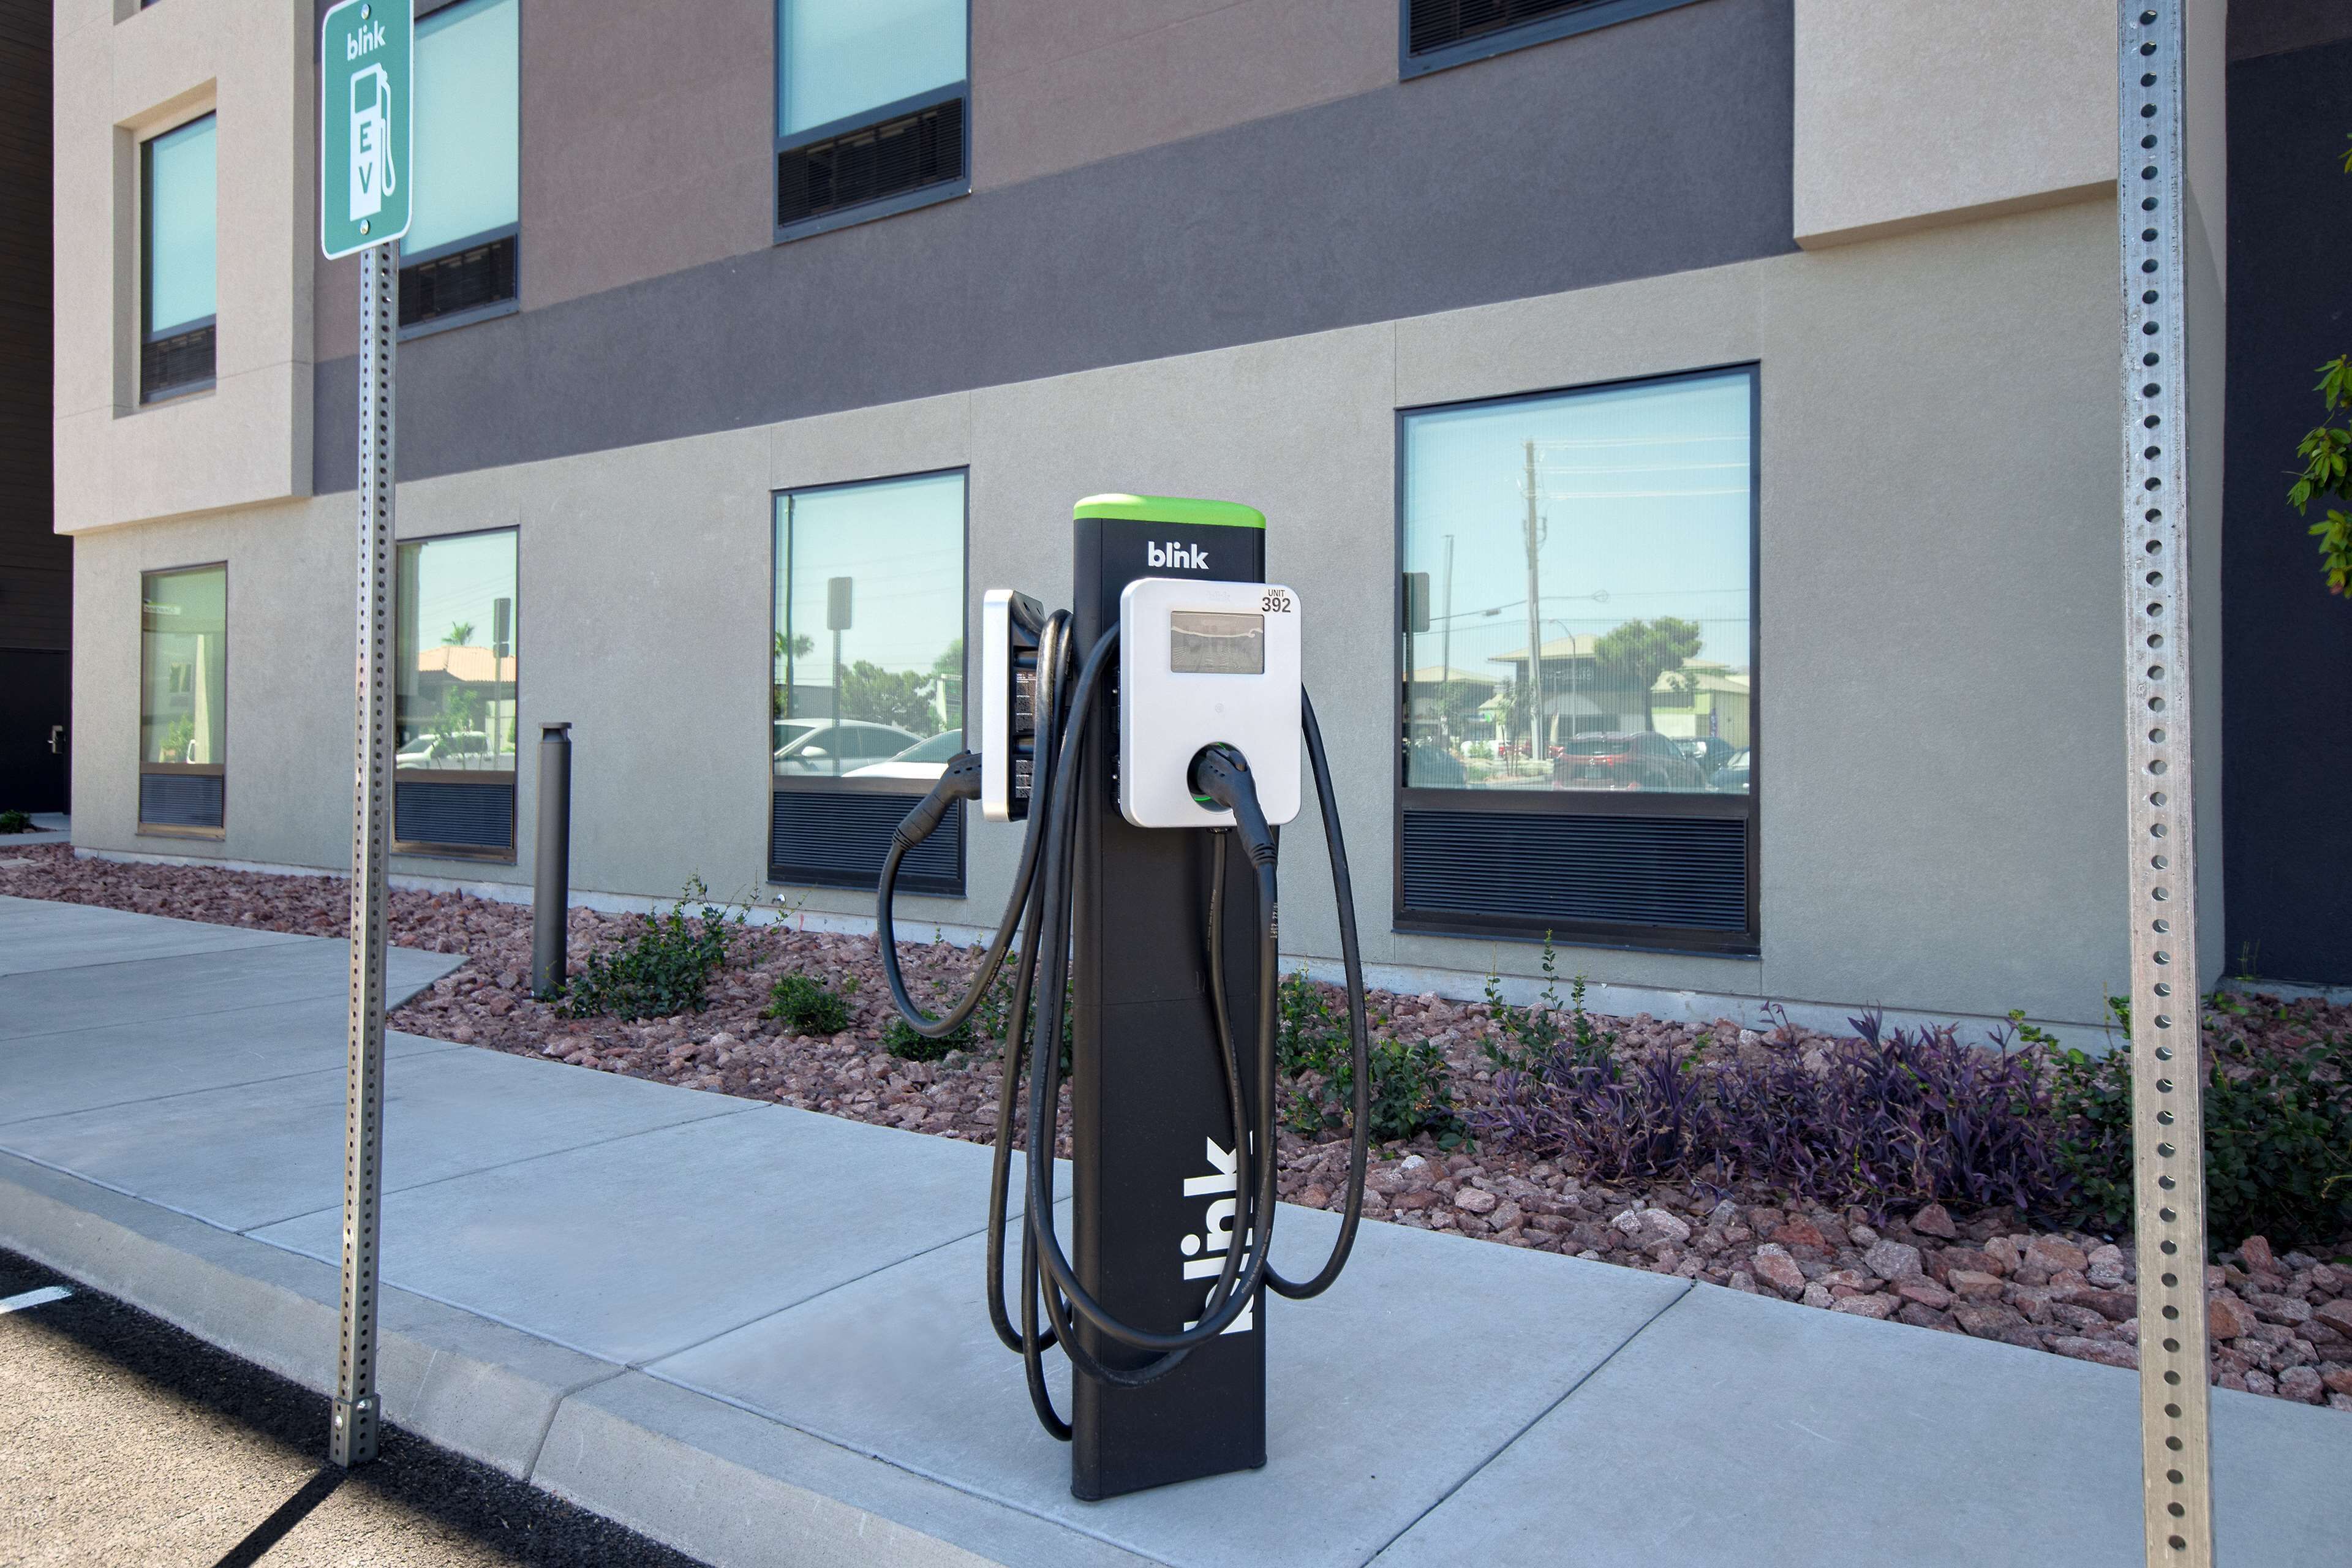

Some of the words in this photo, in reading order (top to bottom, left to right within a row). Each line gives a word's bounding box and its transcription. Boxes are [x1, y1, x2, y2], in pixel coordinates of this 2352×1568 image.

[347, 21, 385, 61] blink
[1148, 541, 1209, 569] blink
[1268, 589, 1285, 597] UNIT
[1262, 597, 1291, 613] 392
